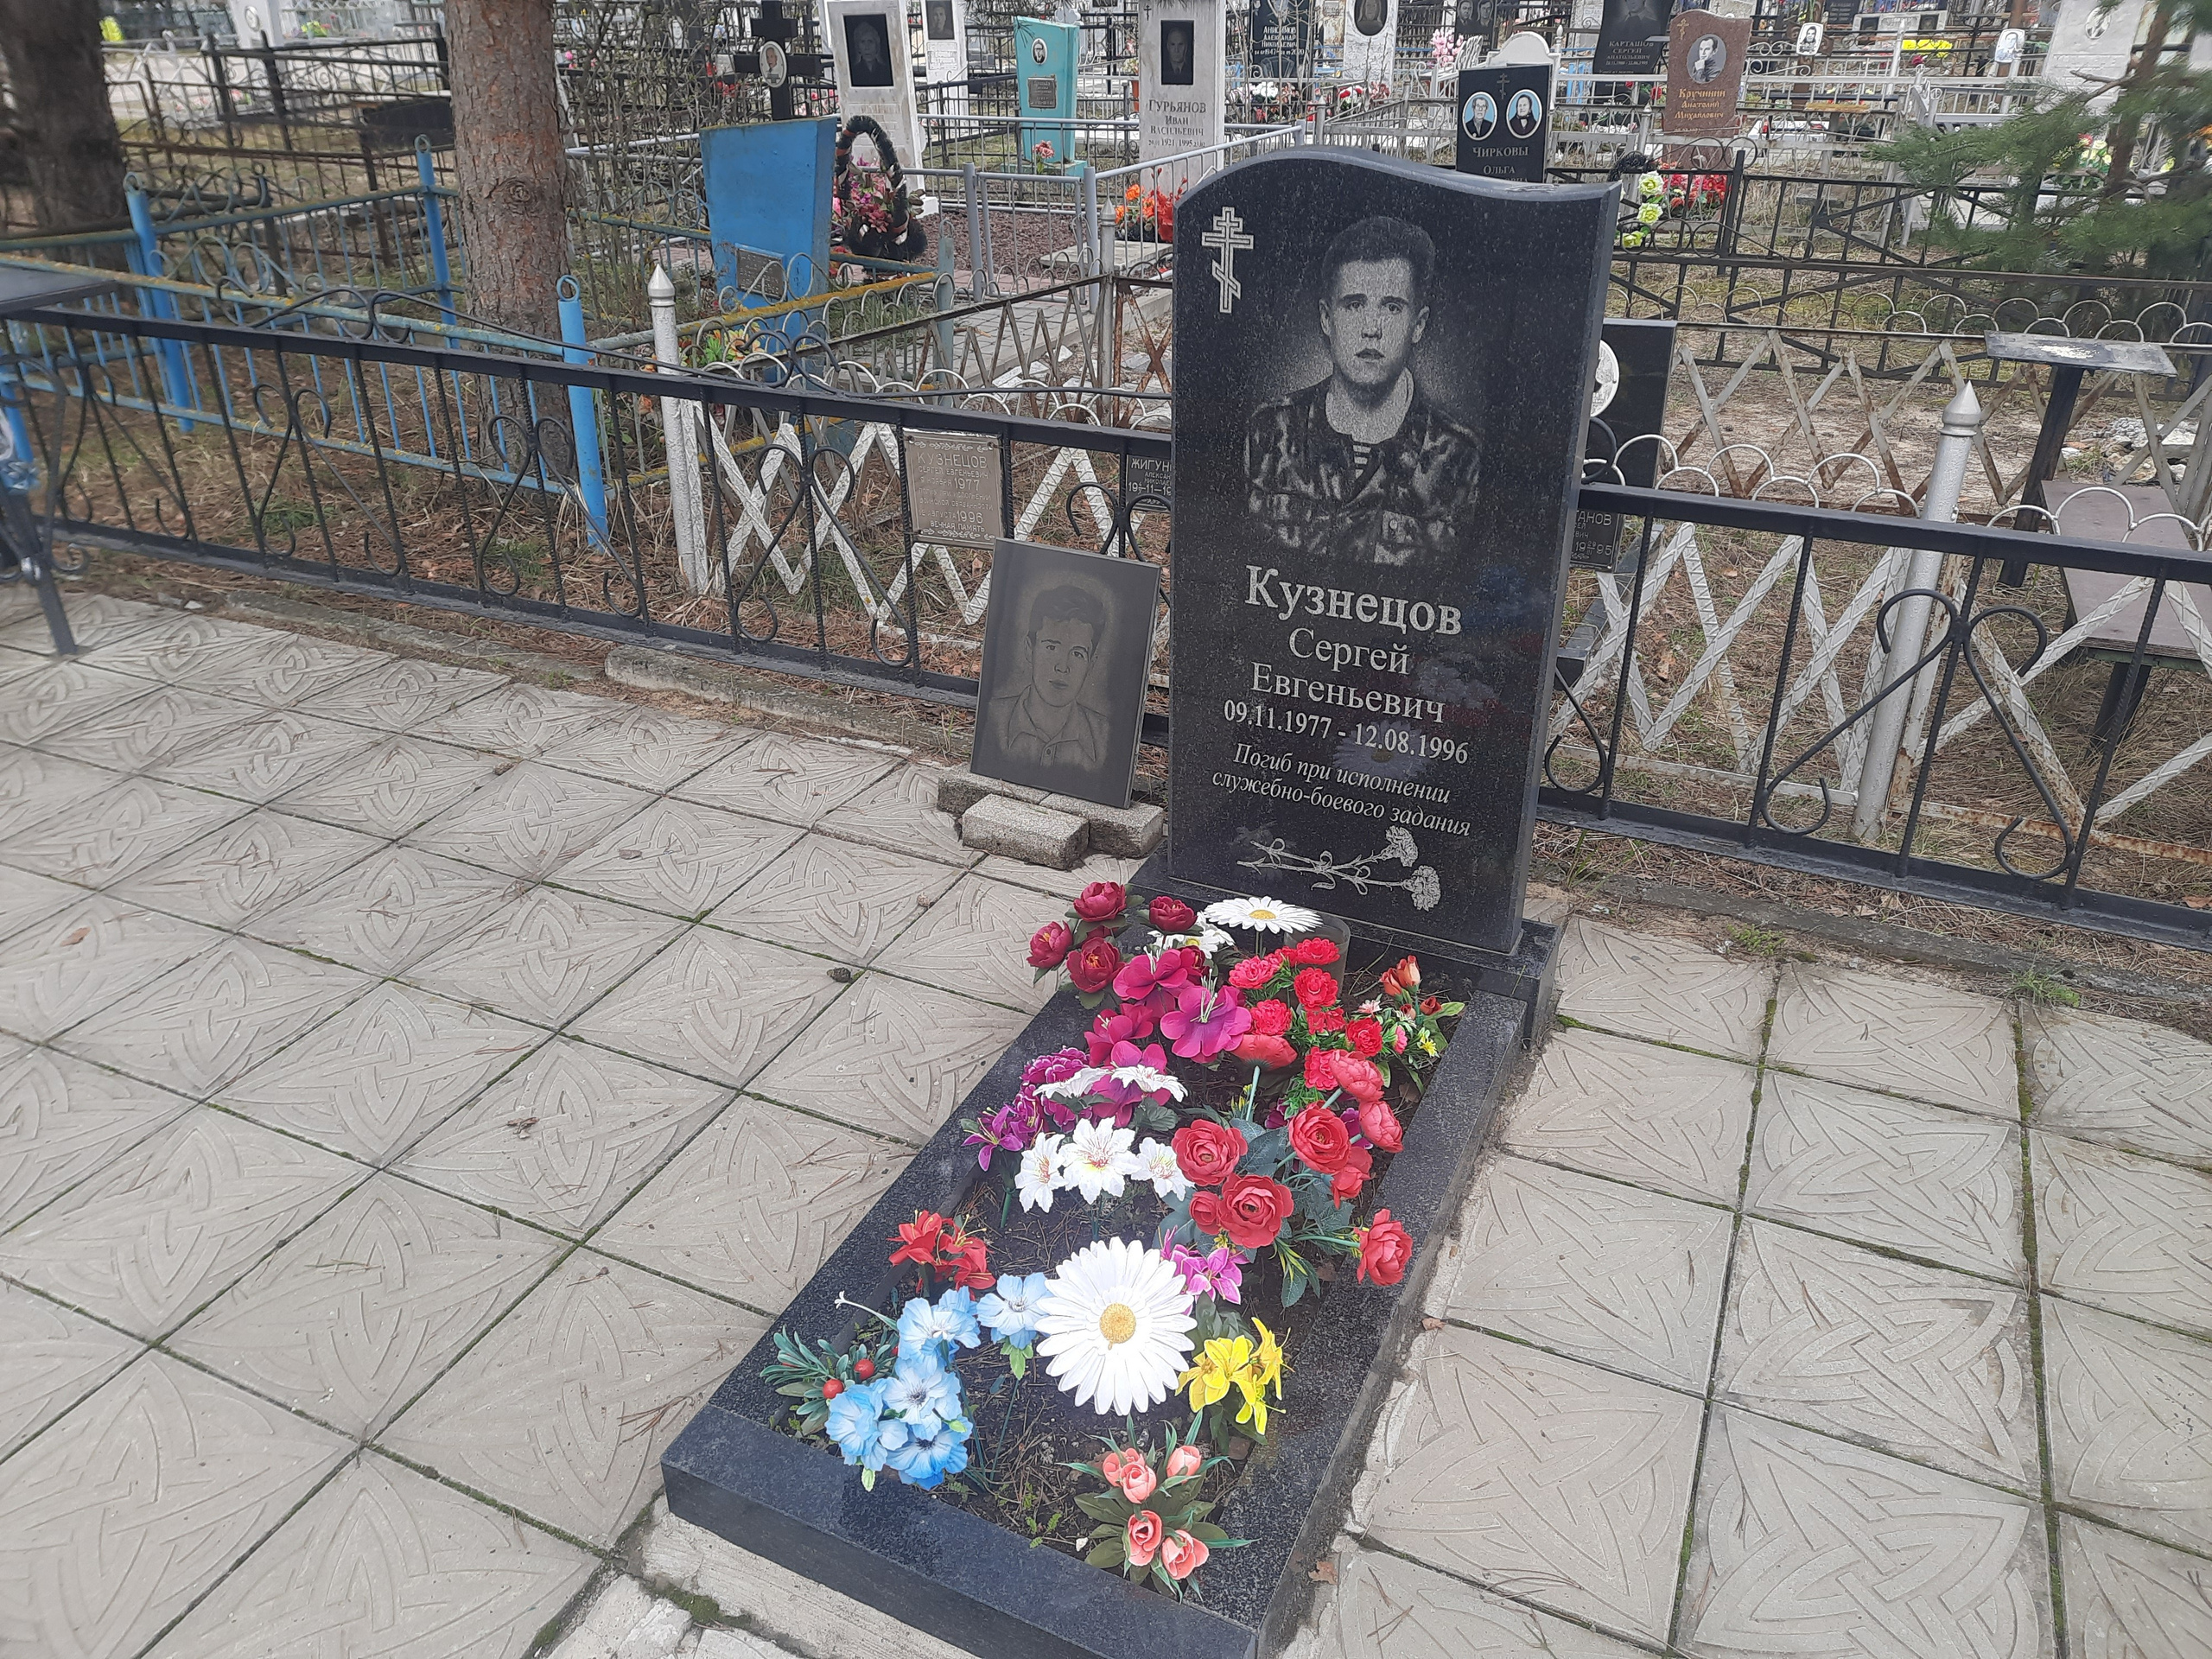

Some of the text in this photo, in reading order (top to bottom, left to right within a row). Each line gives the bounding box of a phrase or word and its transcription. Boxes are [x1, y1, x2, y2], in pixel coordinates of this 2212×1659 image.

[1148, 99, 1206, 113] ГУРЬЯНОВ
[1165, 115, 1189, 125] ИВАН
[1150, 125, 1204, 136] ВАСИЛЬЕВИЧ
[1472, 146, 1529, 157] ЧИРКОВЫ
[1483, 165, 1516, 175] ОЛЬГА
[917, 452, 988, 469] КУЗНЕЦОВ
[1131, 458, 1172, 472] ЖИГУН
[918, 466, 989, 480] СЕРГЕЙ ЕВГЕНЬЕВИЧ
[1144, 471, 1171, 480] АЛЕКСАН
[954, 477, 981, 491] 1977
[1144, 477, 1172, 486] НИКОЛАЕ
[957, 510, 983, 524] 1996
[1576, 510, 1612, 525] АНОВ
[930, 520, 986, 532] ВЕЧНАЯ ПАМЯТЬ
[1244, 564, 1463, 635] Кузнецов
[1288, 627, 1410, 675] Сергей
[1250, 661, 1446, 723] Евгеньевич
[1224, 699, 1332, 739] 09.11.1977
[1354, 722, 1469, 764] 12.08.1996
[1233, 743, 1451, 804] Погиб при исполнении
[1212, 771, 1471, 836] служебно-боевого задания
